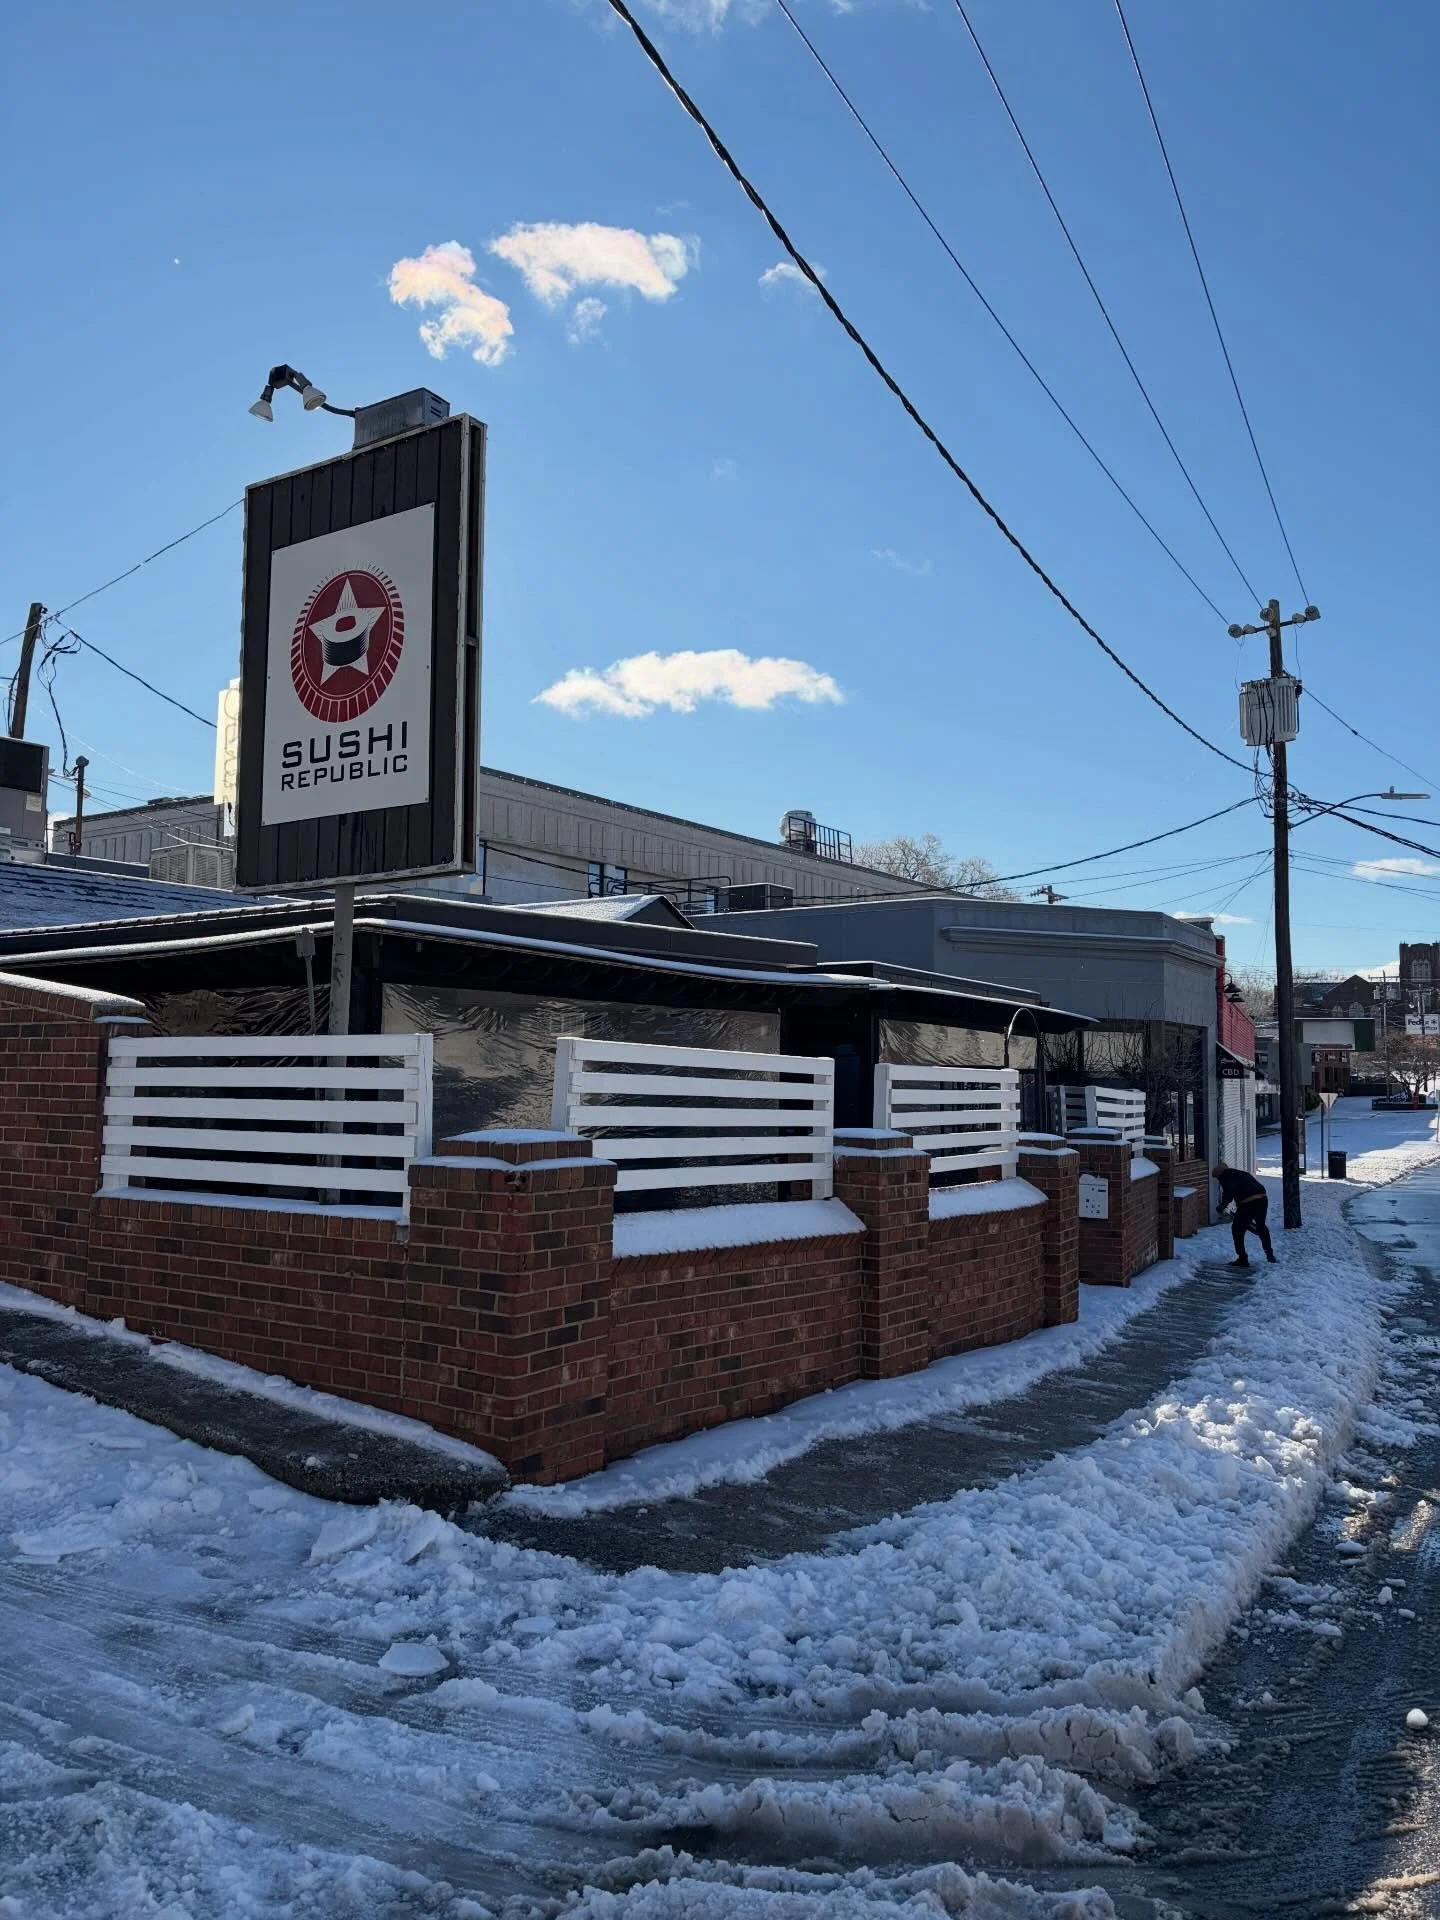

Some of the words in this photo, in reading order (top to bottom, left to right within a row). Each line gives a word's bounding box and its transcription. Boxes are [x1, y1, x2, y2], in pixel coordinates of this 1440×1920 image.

[282, 721, 407, 768] SUSHI
[281, 754, 407, 791] REPUBLIC
[1222, 1068, 1240, 1076] CBD
